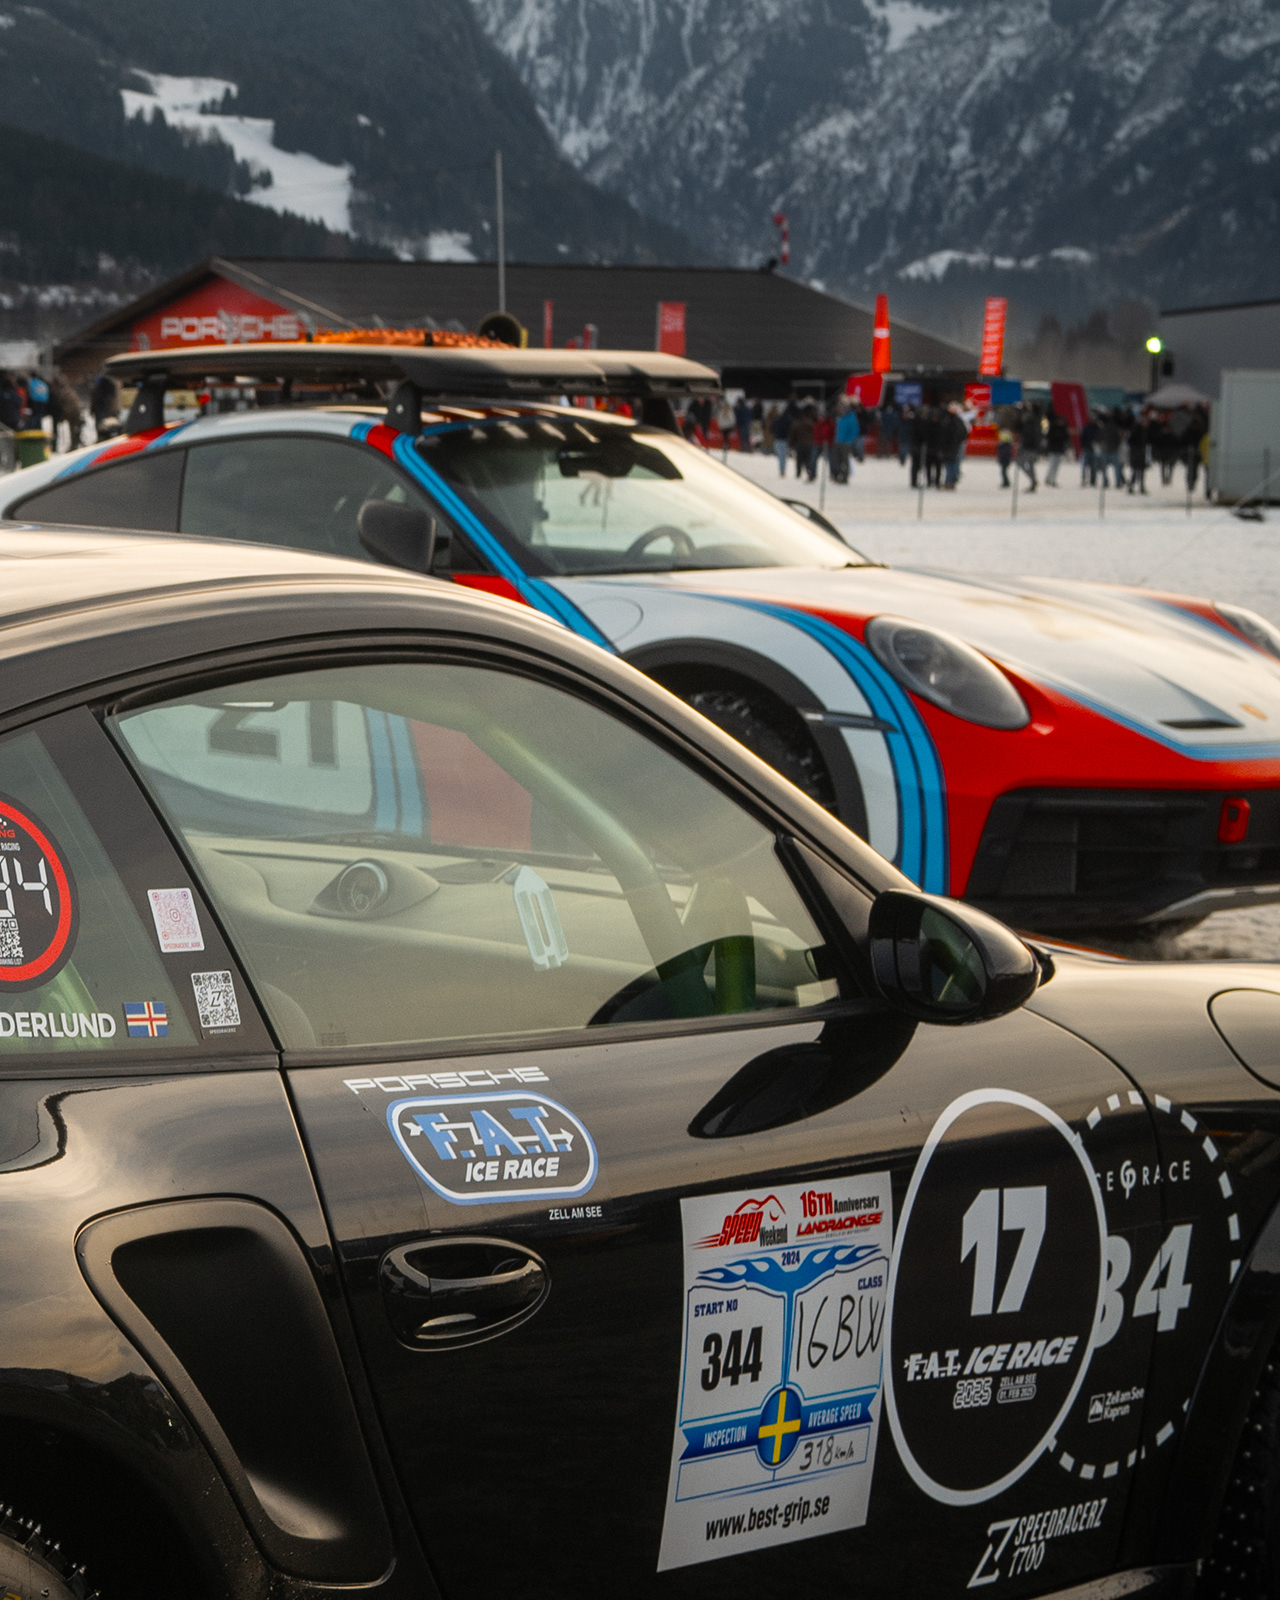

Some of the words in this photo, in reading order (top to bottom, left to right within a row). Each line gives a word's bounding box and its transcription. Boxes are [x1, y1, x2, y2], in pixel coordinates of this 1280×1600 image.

[1, 842, 20, 851] RACING
[342, 1066, 550, 1094] PORSCHE
[465, 1161, 498, 1182] ICE
[503, 1157, 560, 1180] RACE
[1142, 1160, 1191, 1186] RACE
[549, 1208, 570, 1221] ZELL
[571, 1207, 584, 1220] AM
[585, 1206, 602, 1218] SEE
[799, 1190, 833, 1218] 16TH
[834, 1195, 880, 1214] Anniversary
[719, 1211, 764, 1246] SPEED
[760, 1224, 788, 1247] Weekend
[796, 1212, 883, 1237] LANDRACING.SE
[781, 1251, 800, 1266] 2024
[960, 1185, 1047, 1317] 17
[858, 1275, 883, 1290] CLASS
[694, 1301, 722, 1317] START
[726, 1299, 738, 1313] NO
[701, 1326, 763, 1391] 344
[963, 1345, 1012, 1376] ICE
[1006, 1336, 1079, 1371] RACE
[952, 1376, 993, 1410] 2025
[808, 1405, 839, 1428] AVERAGE
[840, 1403, 861, 1422] SPEED
[703, 1425, 747, 1449] INSPECTION
[705, 1495, 831, 1541] www.best-grip.se
[1014, 1497, 1108, 1546] SPEEDRACERZ
[1008, 1540, 1046, 1578] 1700
